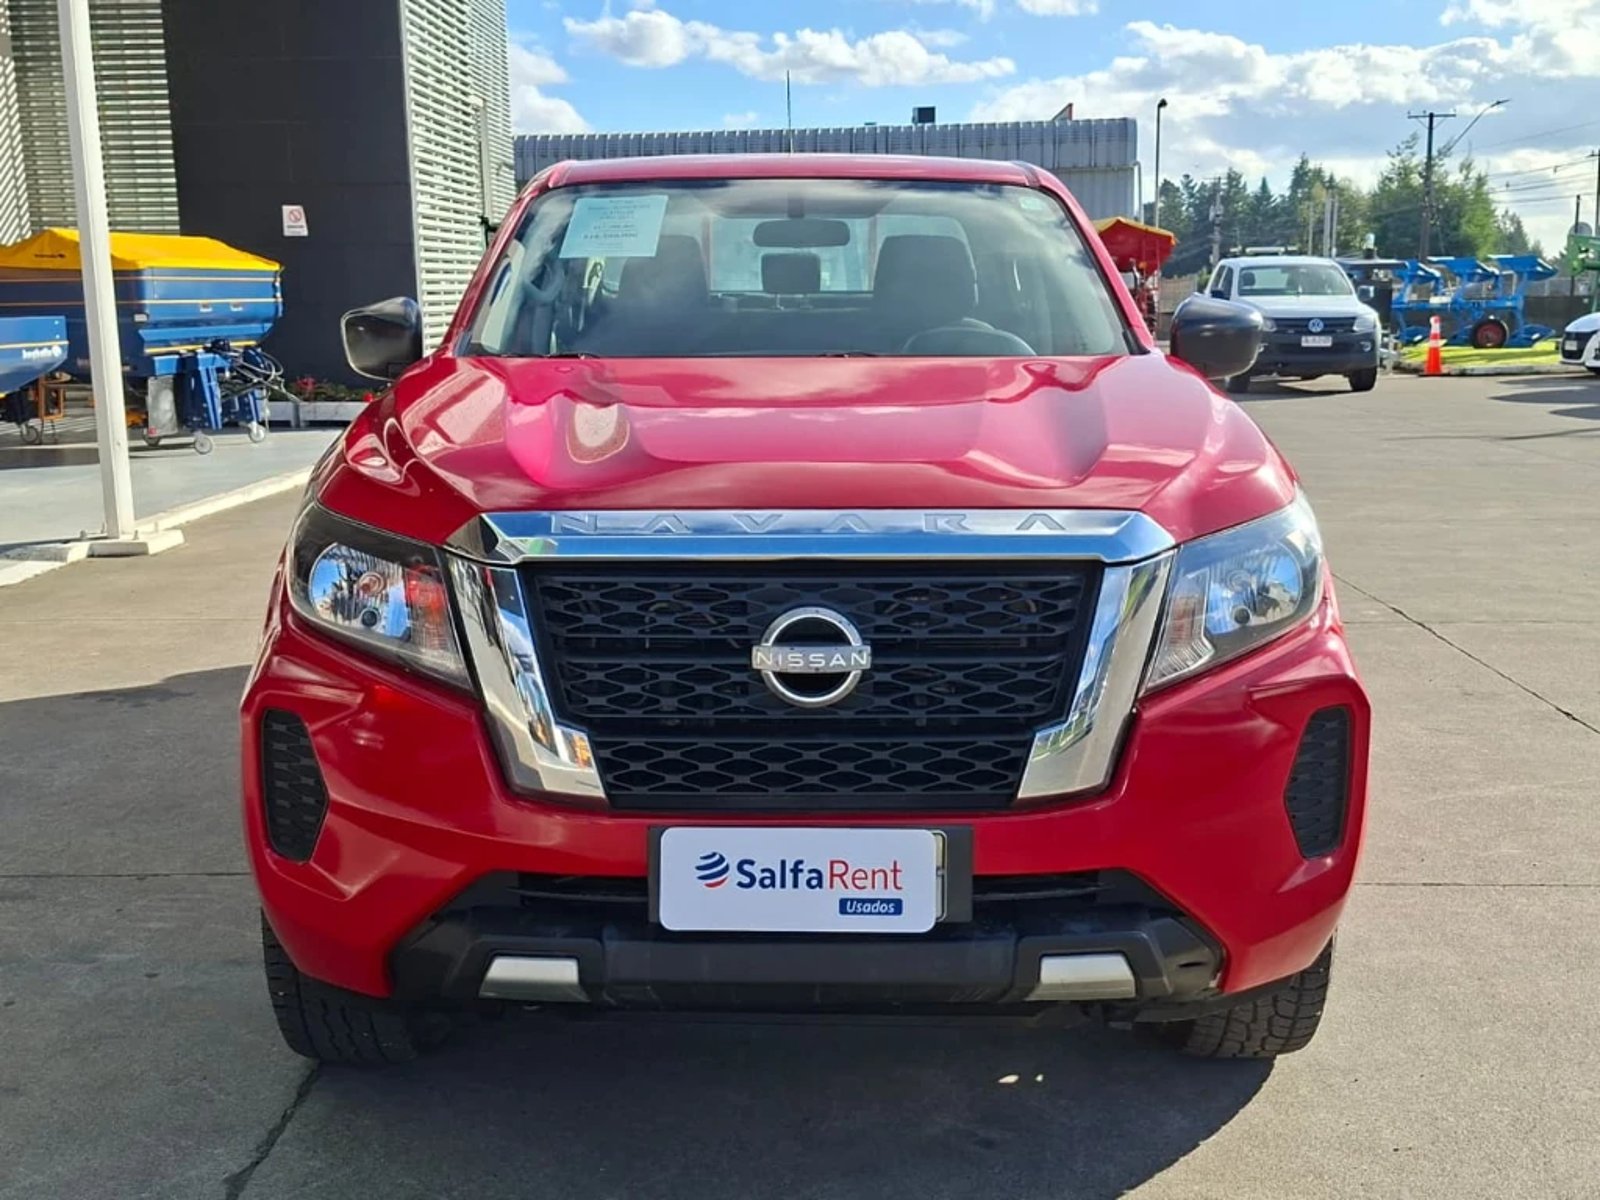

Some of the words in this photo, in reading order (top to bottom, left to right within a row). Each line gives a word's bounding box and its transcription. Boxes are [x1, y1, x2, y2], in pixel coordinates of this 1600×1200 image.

[550, 513, 1067, 534] NAVARA
[756, 651, 867, 667] NISSAN
[736, 858, 903, 890] SalfaRent
[846, 899, 896, 913] Usados
